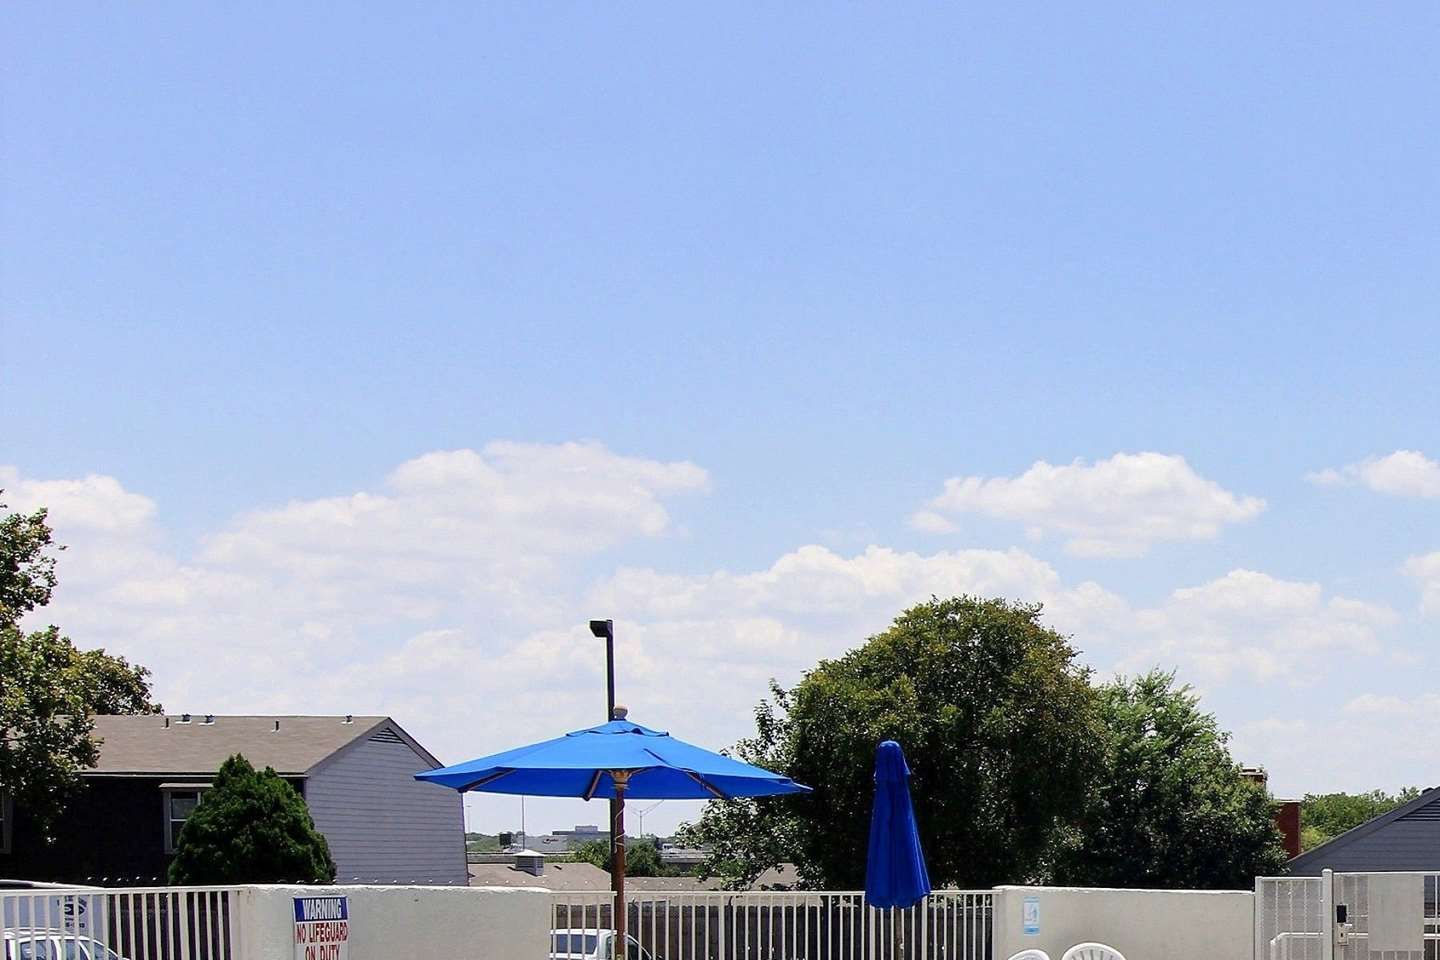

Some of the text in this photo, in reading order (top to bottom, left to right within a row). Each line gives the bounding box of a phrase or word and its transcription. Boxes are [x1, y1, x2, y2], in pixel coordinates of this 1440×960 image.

[303, 898, 342, 920] WARNING
[297, 922, 347, 944] NO LIFEGUARD
